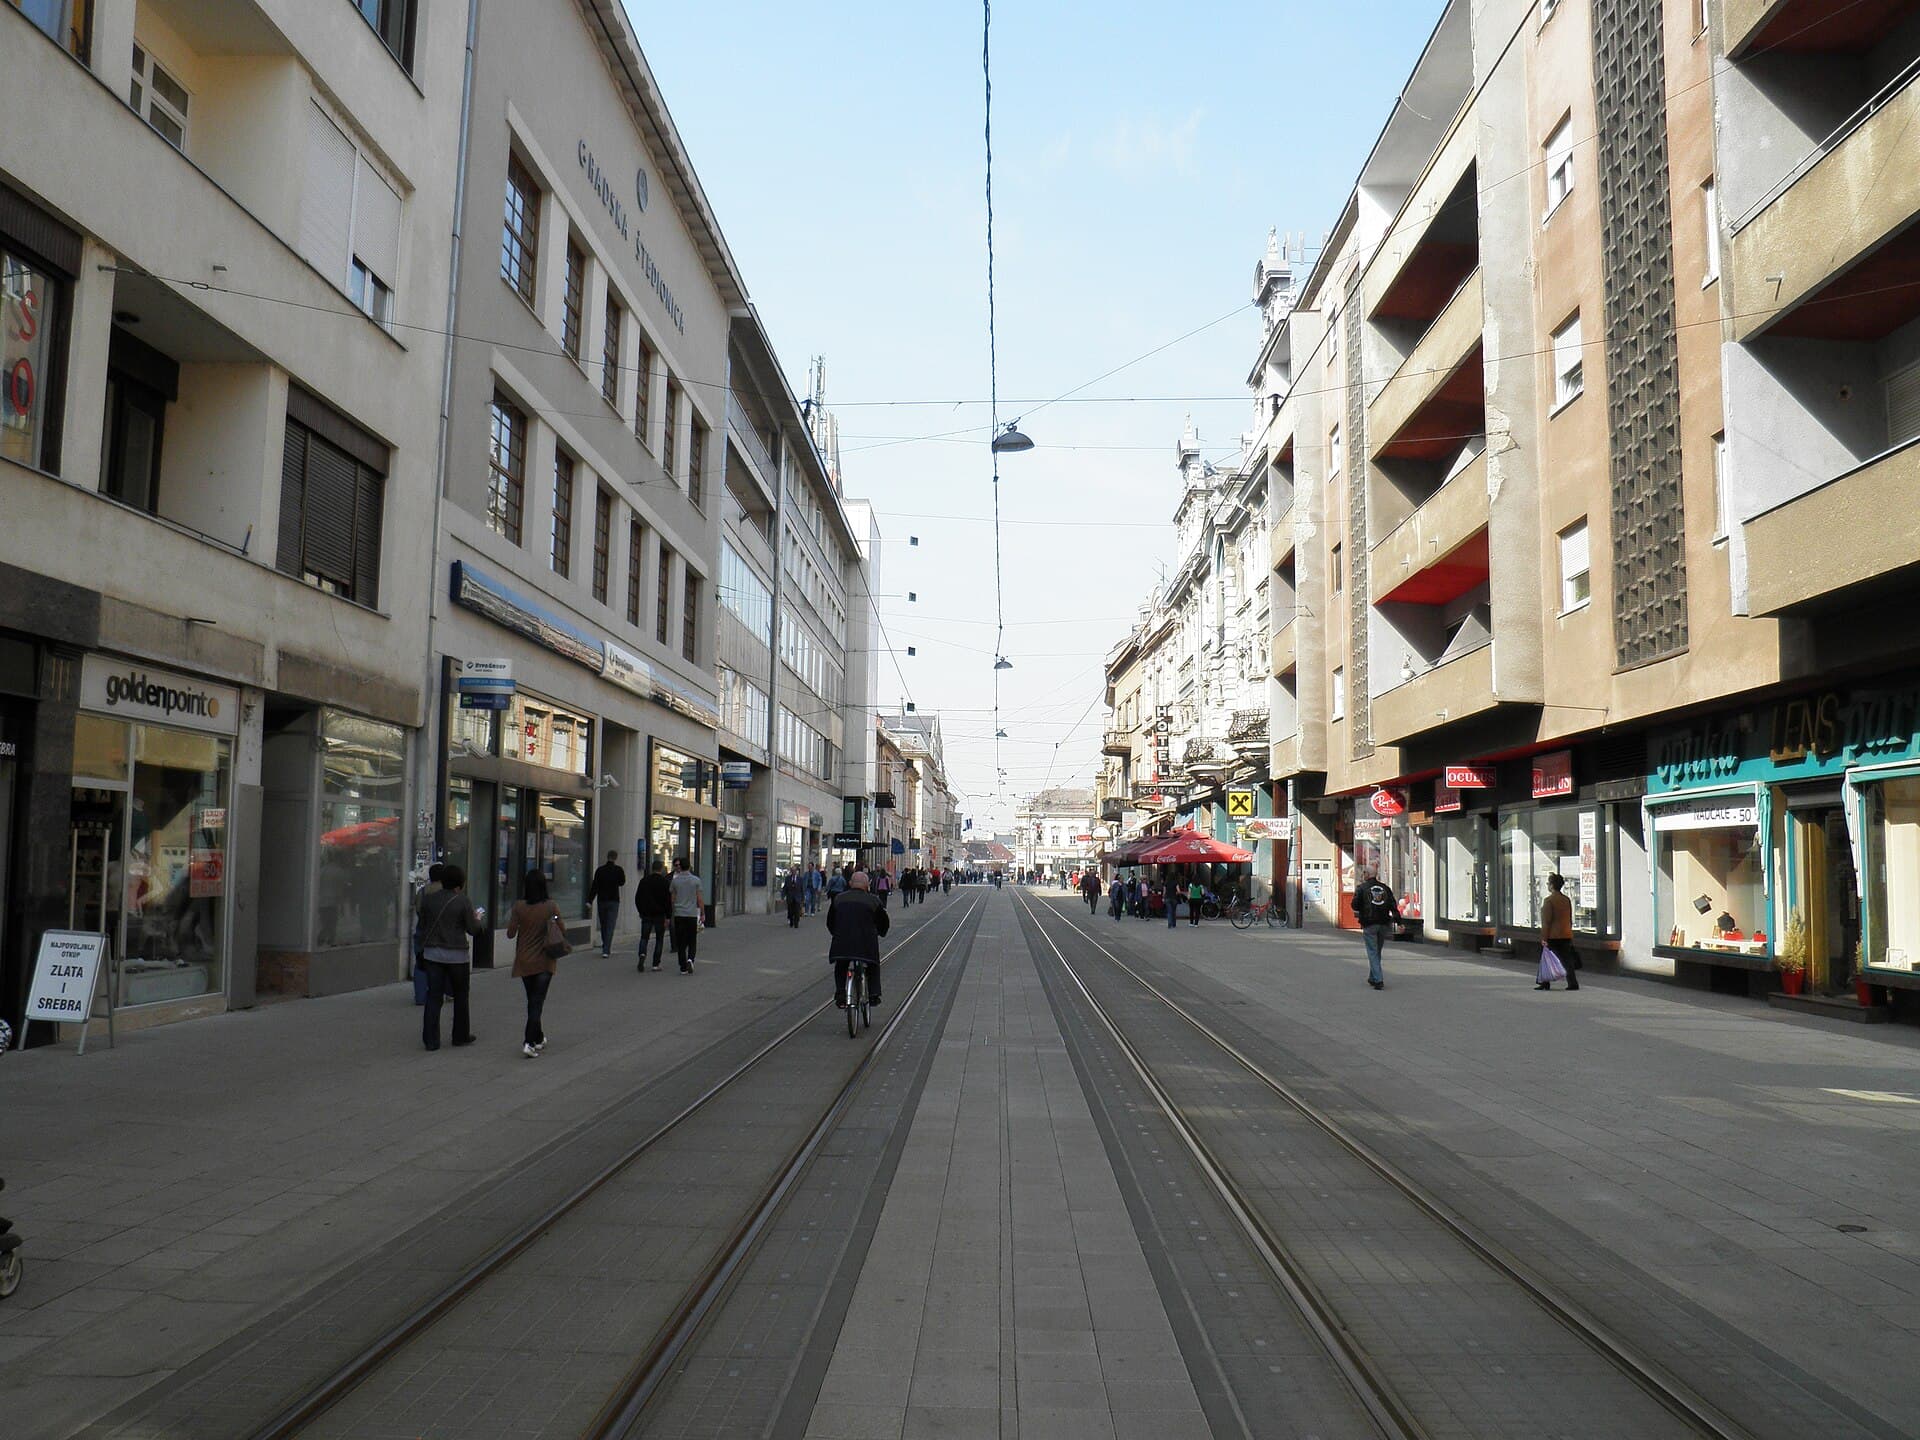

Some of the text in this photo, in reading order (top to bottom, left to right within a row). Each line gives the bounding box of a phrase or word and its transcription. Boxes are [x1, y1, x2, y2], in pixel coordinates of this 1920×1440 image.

[577, 138, 685, 336] GRADSKA ŠTEDIONICA
[106, 671, 207, 716] goldenpoint
[1156, 706, 1169, 776] HOTEL
[1448, 772, 1495, 783] OCULUS
[1139, 786, 1185, 795] ROYAL
[50, 964, 84, 978] ZLATA
[61, 982, 66, 993] I
[37, 997, 82, 1012] SREBRA
